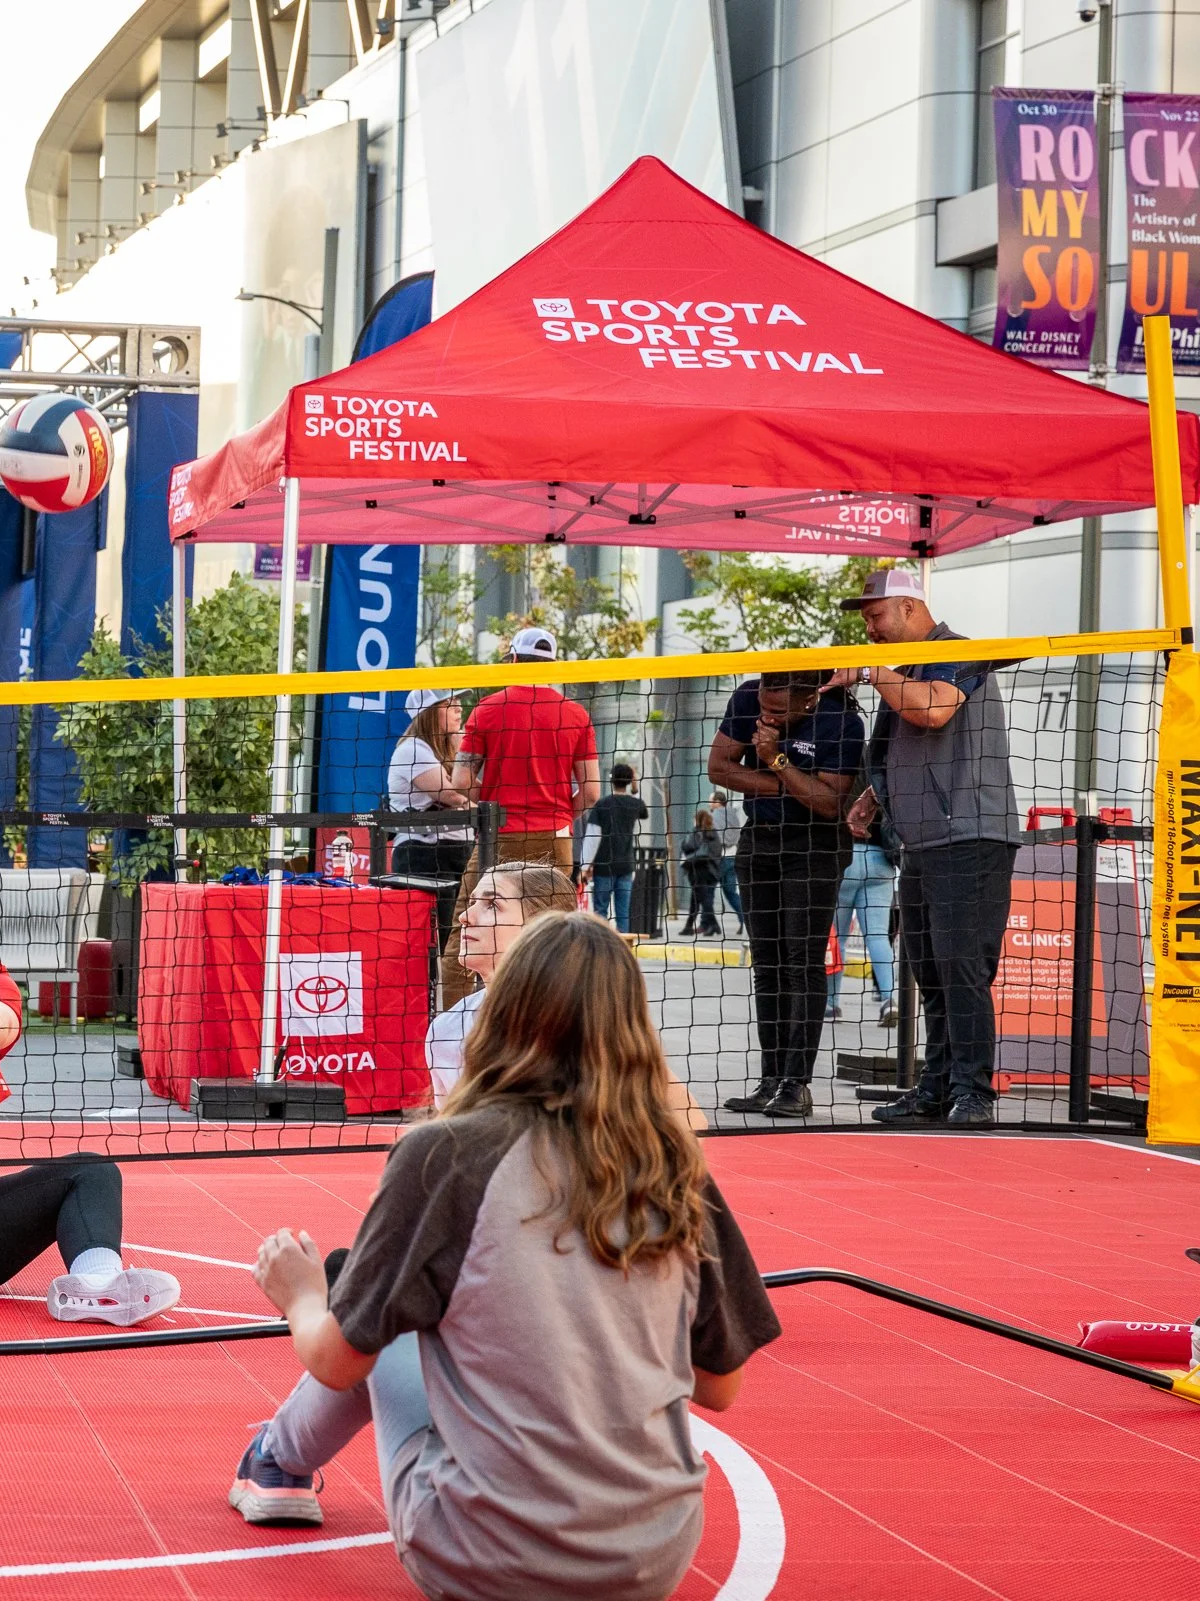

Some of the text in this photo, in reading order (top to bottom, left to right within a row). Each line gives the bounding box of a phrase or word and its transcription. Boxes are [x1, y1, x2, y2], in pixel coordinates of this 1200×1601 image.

[1017, 104, 1057, 116] Oct 30
[1160, 110, 1199, 122] Nov 22
[1019, 124, 1094, 182] RO
[1129, 129, 1199, 189] CK
[1132, 194, 1156, 207] The
[1022, 189, 1088, 239] MY
[1132, 212, 1198, 228] Artistry of
[1132, 229, 1166, 243] Black
[1020, 245, 1094, 312] SO
[1130, 250, 1198, 316] UL
[586, 298, 806, 327] TOYOTA
[541, 320, 739, 348] SPORTS
[1006, 330, 1081, 343] WALT DISNEY
[1003, 342, 1080, 356] CONCERT HALL
[638, 347, 884, 376] FESTIVAL
[331, 396, 438, 419] TOYOTA
[304, 417, 402, 439] SPORTS
[349, 440, 467, 463] FESTIVAL
[1161, 770, 1176, 957] multi-sport 18-foot portable net system
[1012, 933, 1072, 947] CLINICS
[274, 1051, 376, 1075] OYOTA
